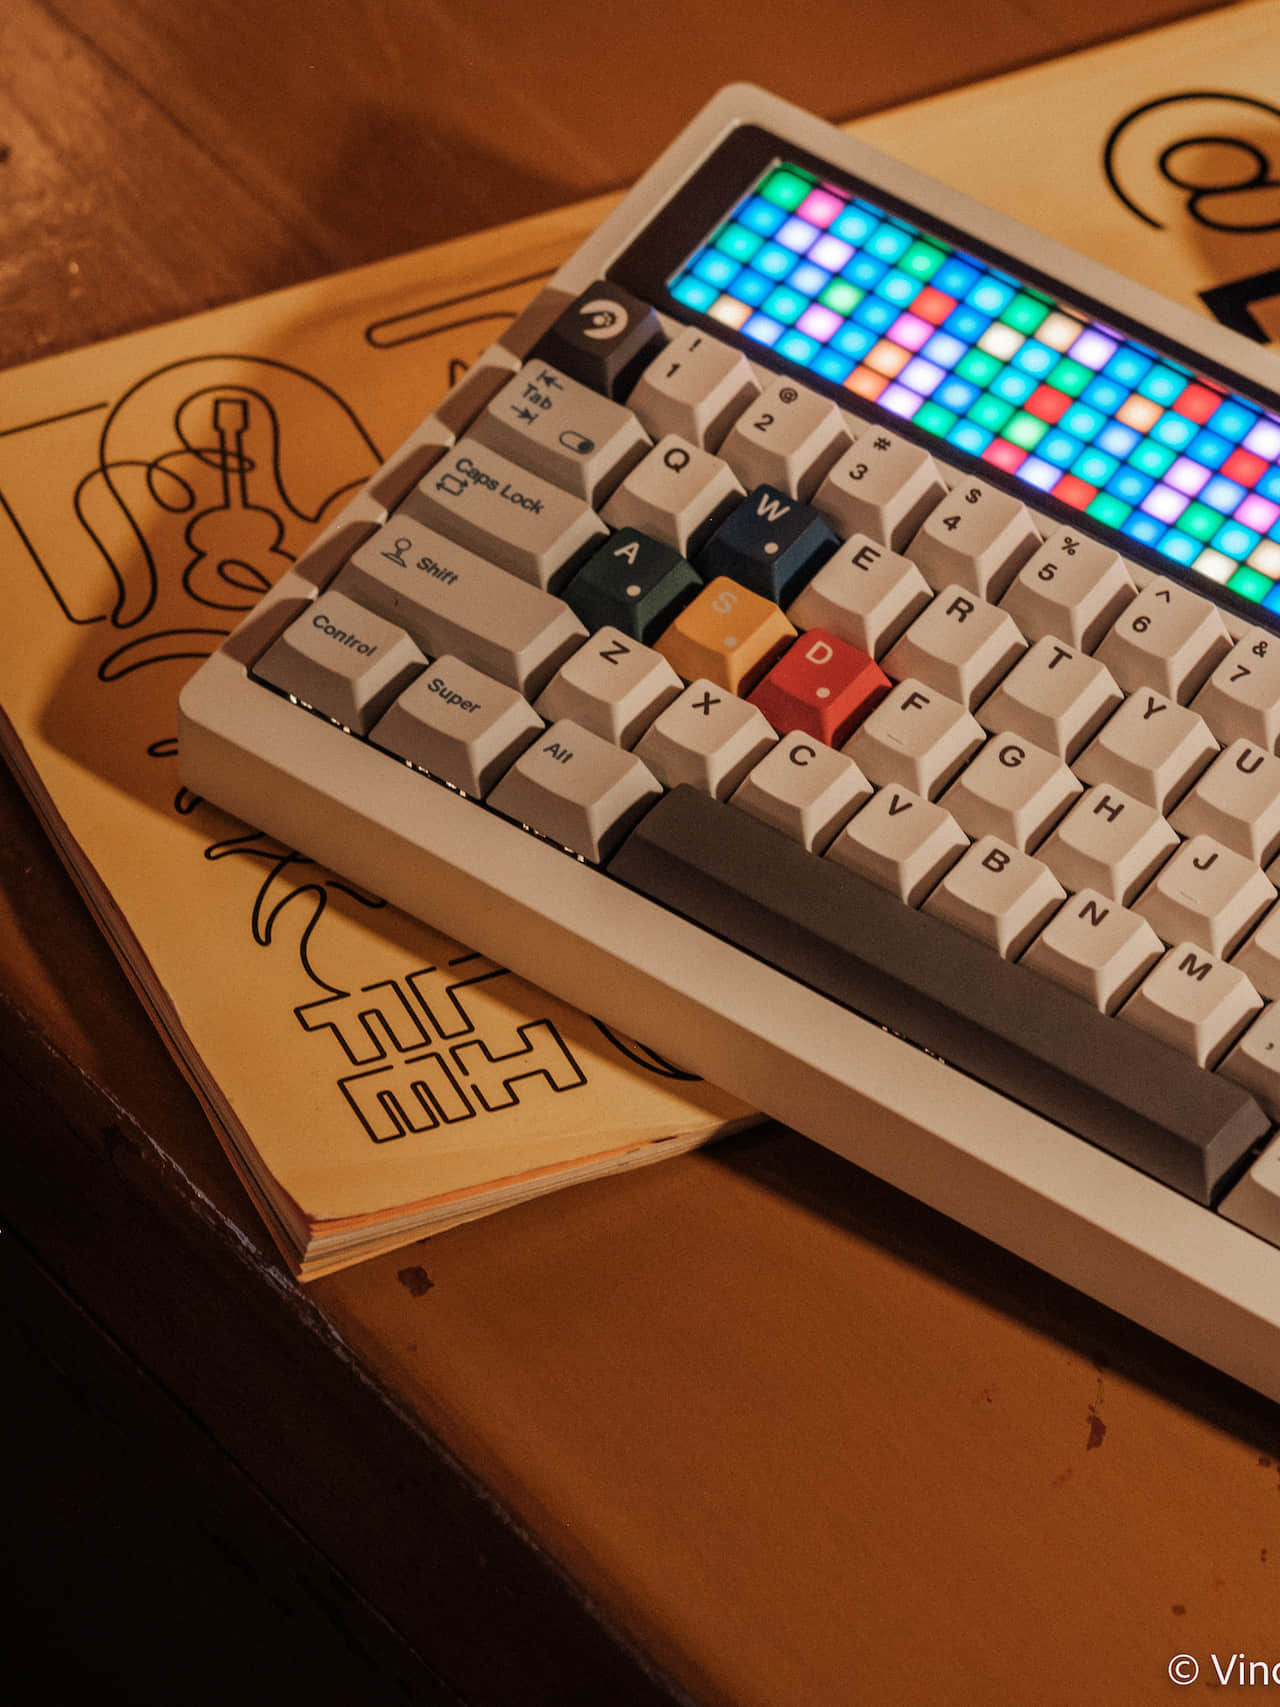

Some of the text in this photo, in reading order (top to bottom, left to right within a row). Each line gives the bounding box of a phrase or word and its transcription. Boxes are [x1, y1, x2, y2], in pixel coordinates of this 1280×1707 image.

[666, 363, 681, 378] 1
[522, 383, 553, 410] Tab
[778, 387, 799, 405] @
[753, 413, 775, 432] 2
[873, 437, 891, 451] #
[663, 447, 691, 474] Q
[849, 463, 869, 481] 3
[455, 457, 545, 515] Caps Lock
[965, 488, 982, 504] $
[756, 493, 791, 522] W
[942, 515, 962, 532] 4
[613, 542, 640, 565] A
[1061, 536, 1080, 556] %
[851, 545, 881, 572] E
[416, 557, 459, 585] Shift
[1037, 563, 1058, 581] 5
[711, 591, 738, 614] S
[945, 596, 975, 623] R
[312, 614, 378, 657] Control
[1132, 615, 1152, 633] 6
[599, 640, 631, 665] Z
[805, 640, 833, 665] D
[1048, 646, 1073, 670] T
[1251, 640, 1269, 658] &
[1229, 664, 1251, 683] 7
[427, 678, 482, 713] Super
[691, 691, 721, 716] X
[900, 691, 931, 711] F
[1143, 696, 1167, 720] Y
[542, 743, 574, 764] Alt
[789, 744, 817, 767] C
[998, 745, 1026, 768] G
[1235, 748, 1265, 774] U
[888, 794, 913, 817] V
[1092, 795, 1125, 823] H
[981, 848, 1011, 873] B
[1192, 853, 1219, 871] J
[1078, 900, 1110, 927] N
[1178, 953, 1213, 982] M
